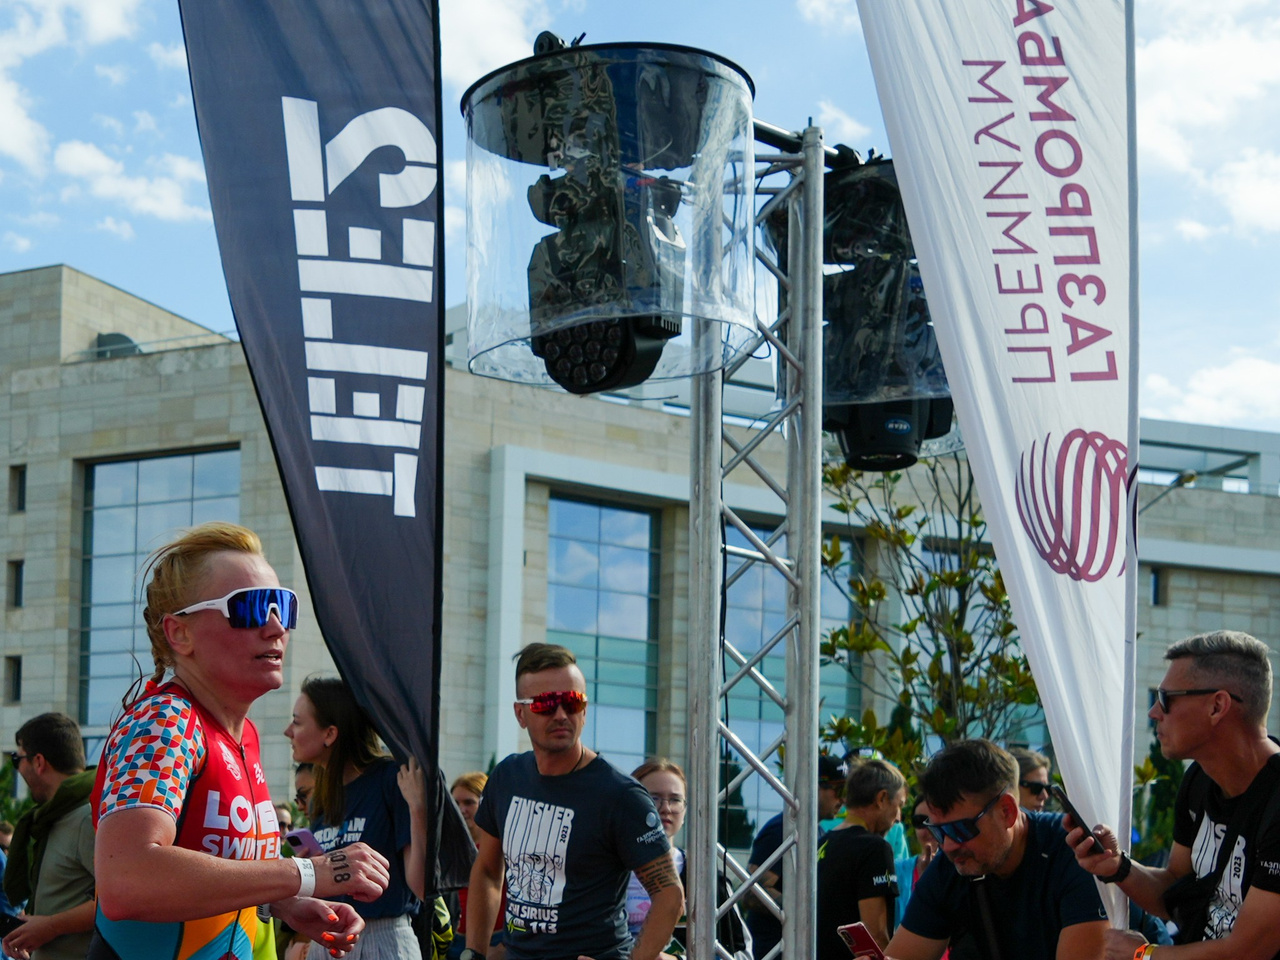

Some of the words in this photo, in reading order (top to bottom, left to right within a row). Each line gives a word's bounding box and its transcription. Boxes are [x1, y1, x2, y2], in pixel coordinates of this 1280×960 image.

[1233, 856, 1242, 879] 2023
[520, 905, 558, 922] SIRIUS
[530, 921, 558, 934] 113
